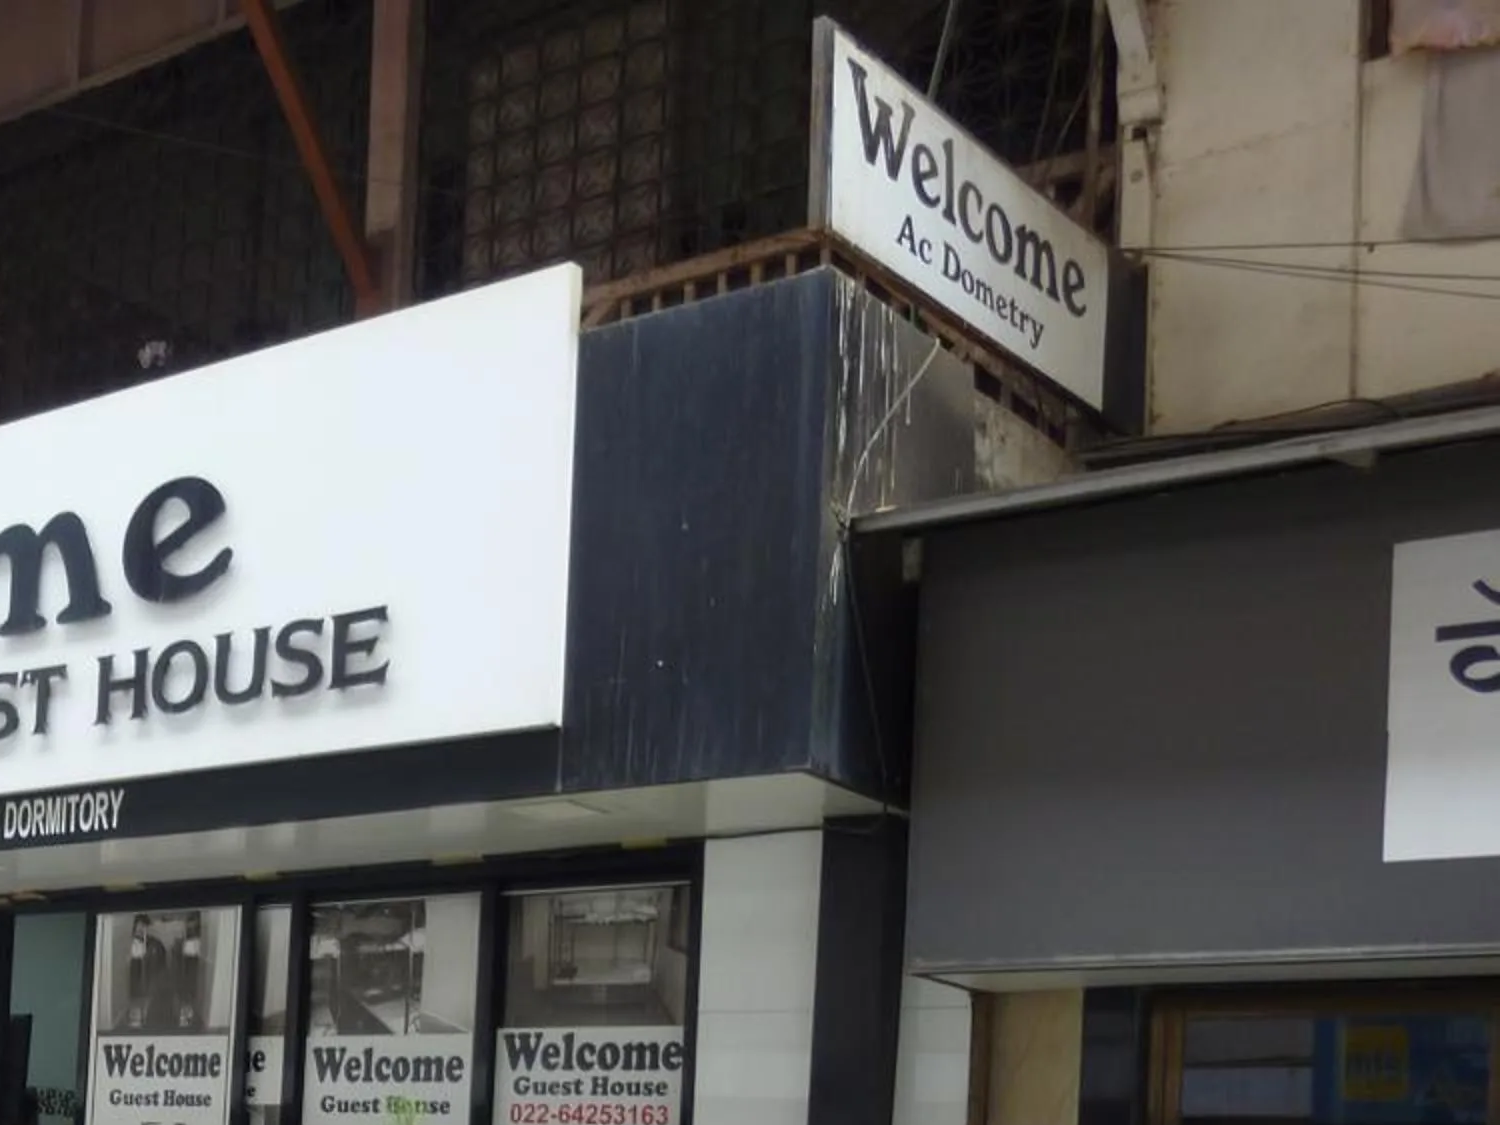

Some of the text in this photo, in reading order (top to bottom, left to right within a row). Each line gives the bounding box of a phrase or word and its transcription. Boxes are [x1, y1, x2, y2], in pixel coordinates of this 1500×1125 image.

[847, 57, 1087, 318] Welcome
[896, 213, 1045, 350] Ac Dometry
[93, 605, 390, 727] HOUSE
[4, 790, 125, 840] DORMITORY
[102, 1043, 222, 1078] Welcome
[312, 1047, 465, 1084] Welcome
[503, 1031, 684, 1073] Welcome
[109, 1088, 213, 1107] Guest House
[320, 1095, 381, 1115] Guest
[512, 1075, 669, 1097] Guest House
